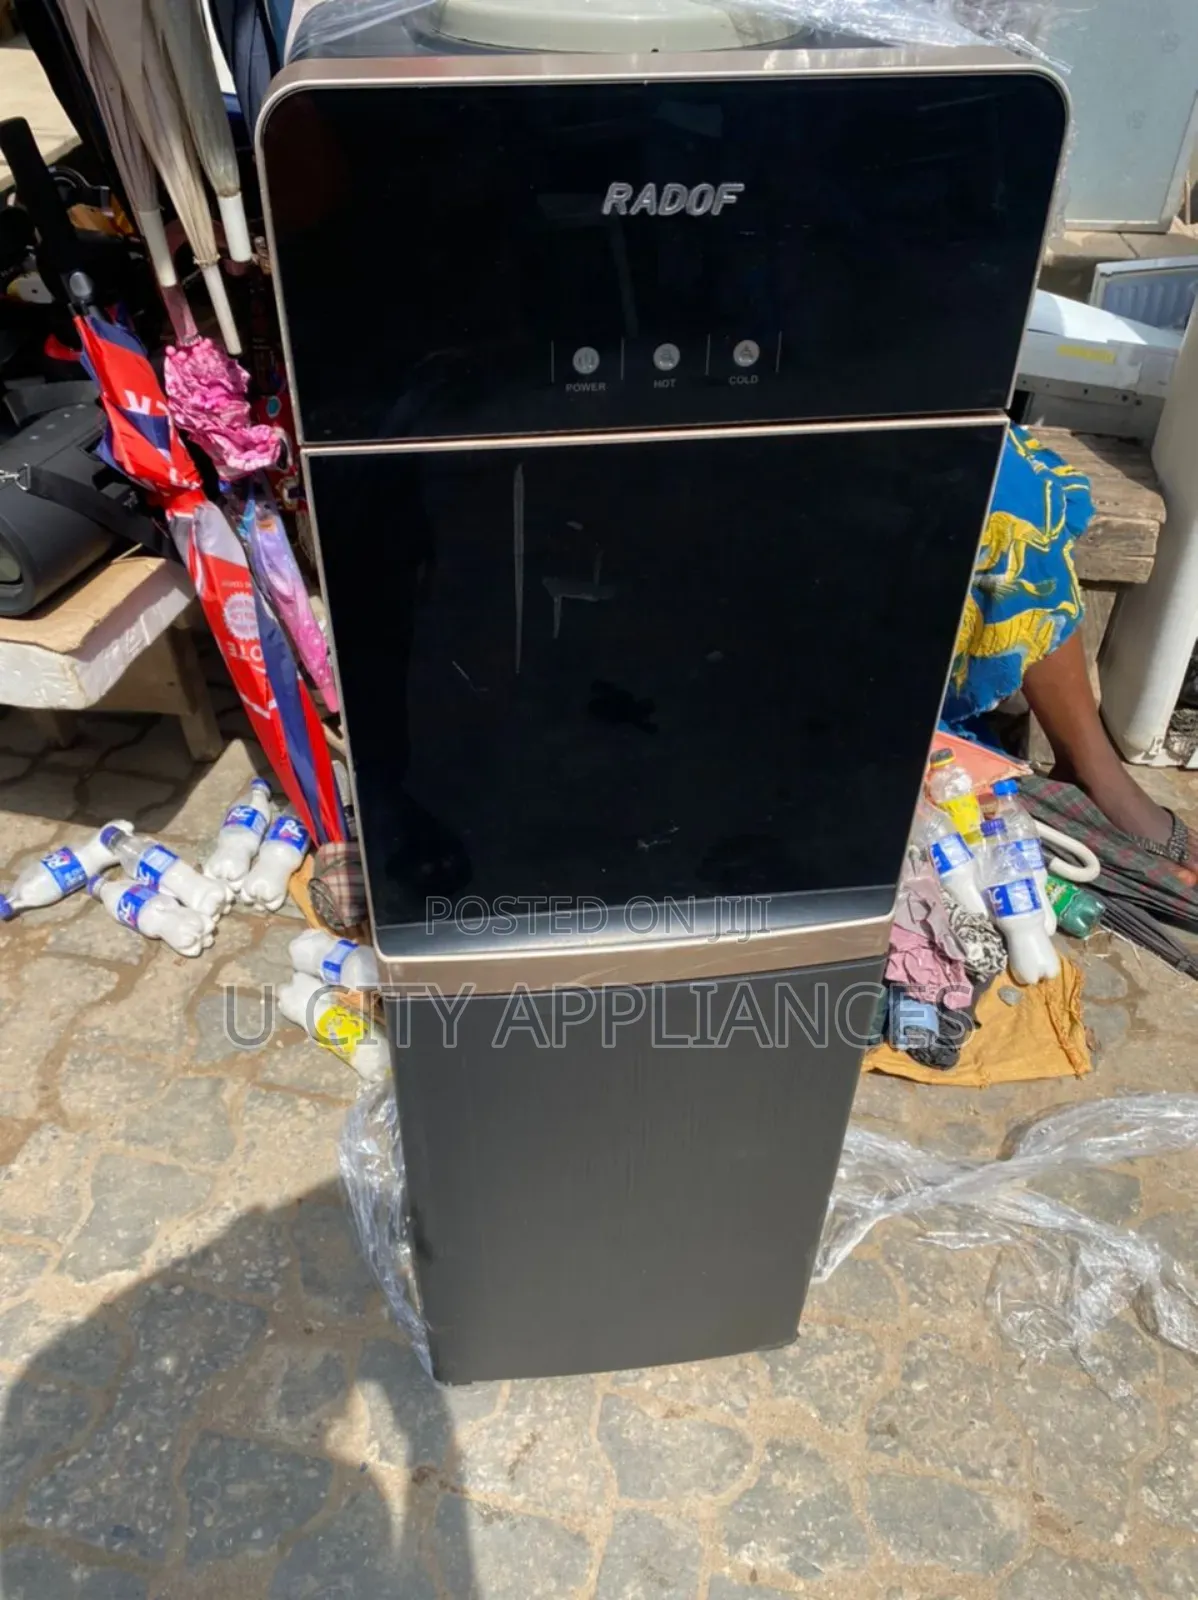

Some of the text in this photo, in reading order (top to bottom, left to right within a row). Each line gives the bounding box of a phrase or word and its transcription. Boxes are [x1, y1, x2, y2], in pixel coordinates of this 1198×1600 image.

[602, 182, 745, 216] RADOF
[653, 378, 677, 389] HOT
[729, 375, 759, 386] COLD
[565, 382, 607, 393] POWER
